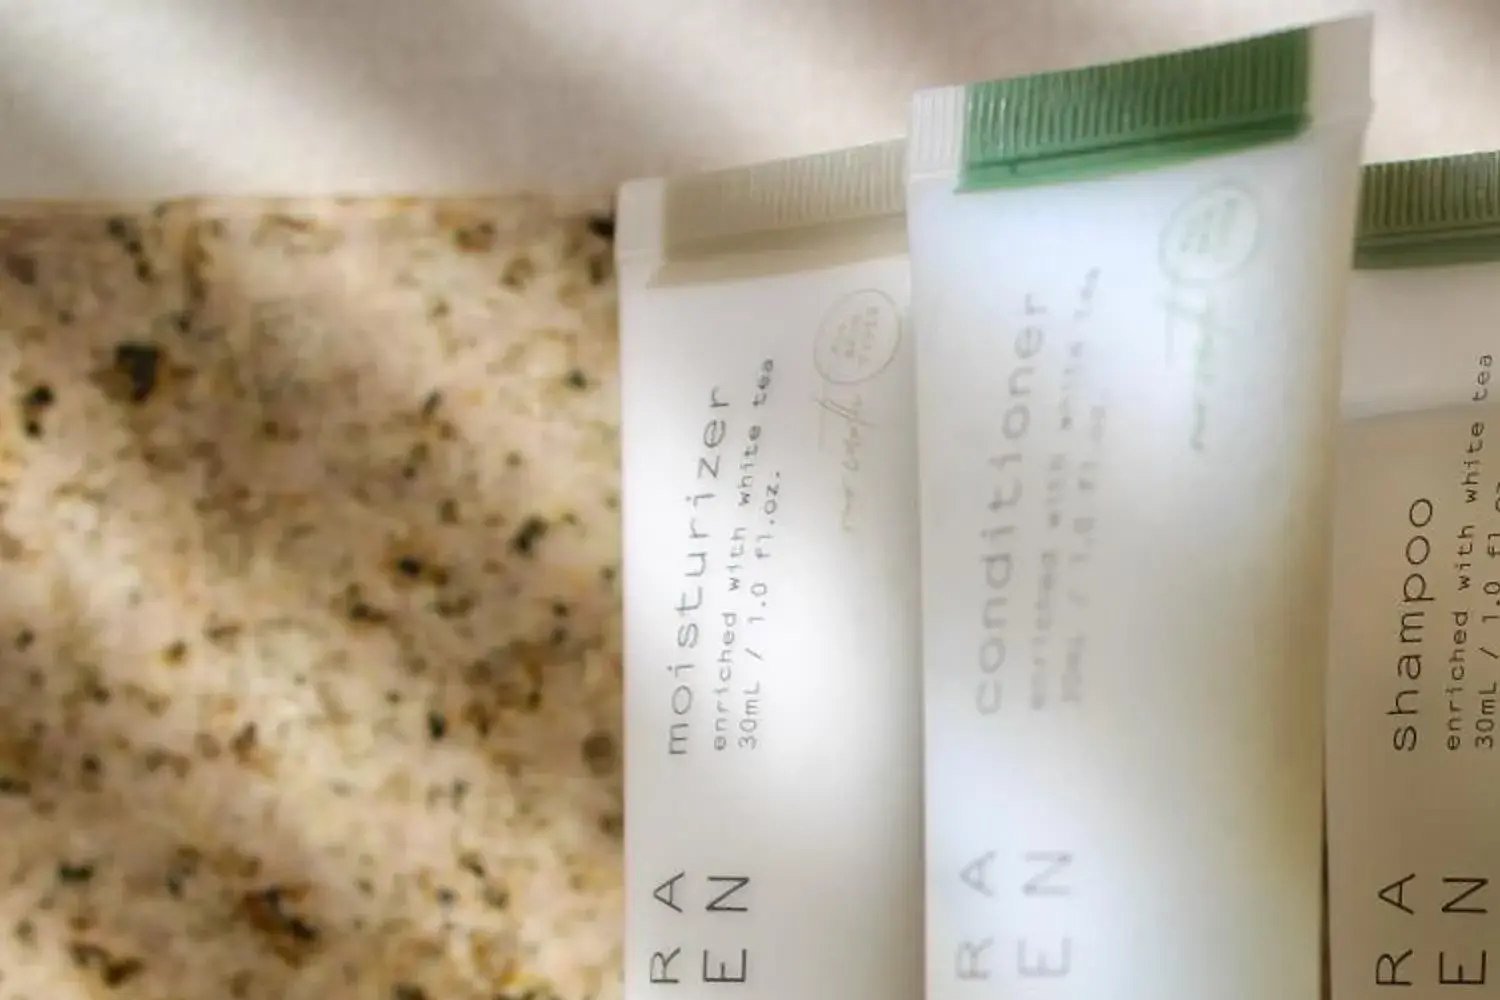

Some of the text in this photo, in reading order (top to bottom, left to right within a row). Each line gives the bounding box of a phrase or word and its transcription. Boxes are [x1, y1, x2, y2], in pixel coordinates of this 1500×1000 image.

[668, 387, 729, 755] moisturizer
[713, 358, 774, 751] enriched with white tea
[747, 583, 768, 623] 1.0
[976, 294, 1047, 715] conditioner
[1386, 498, 1434, 751] shampoo
[1447, 354, 1492, 751] enriched with white tea
[738, 681, 761, 751] 30mL
[1475, 681, 1496, 750] 30mL
